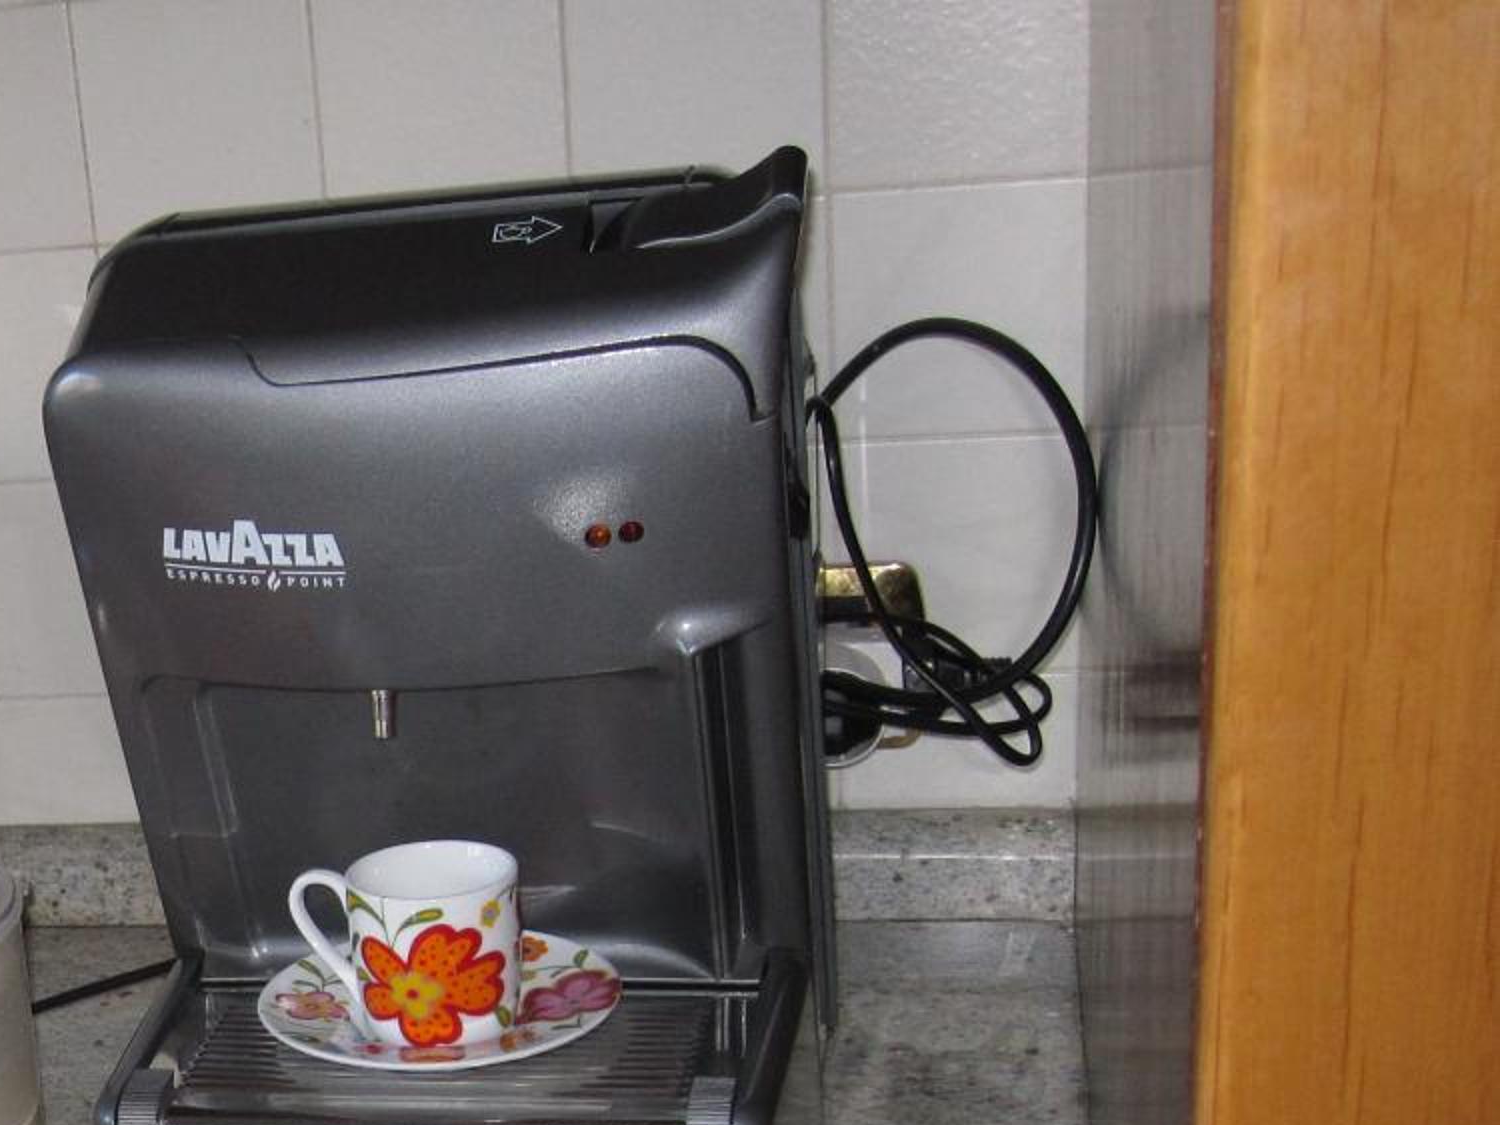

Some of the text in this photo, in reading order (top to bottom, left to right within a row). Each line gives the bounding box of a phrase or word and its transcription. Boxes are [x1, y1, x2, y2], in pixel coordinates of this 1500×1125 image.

[163, 519, 345, 567] LAVAZZA
[166, 568, 346, 588] ESPRESSO POINT
